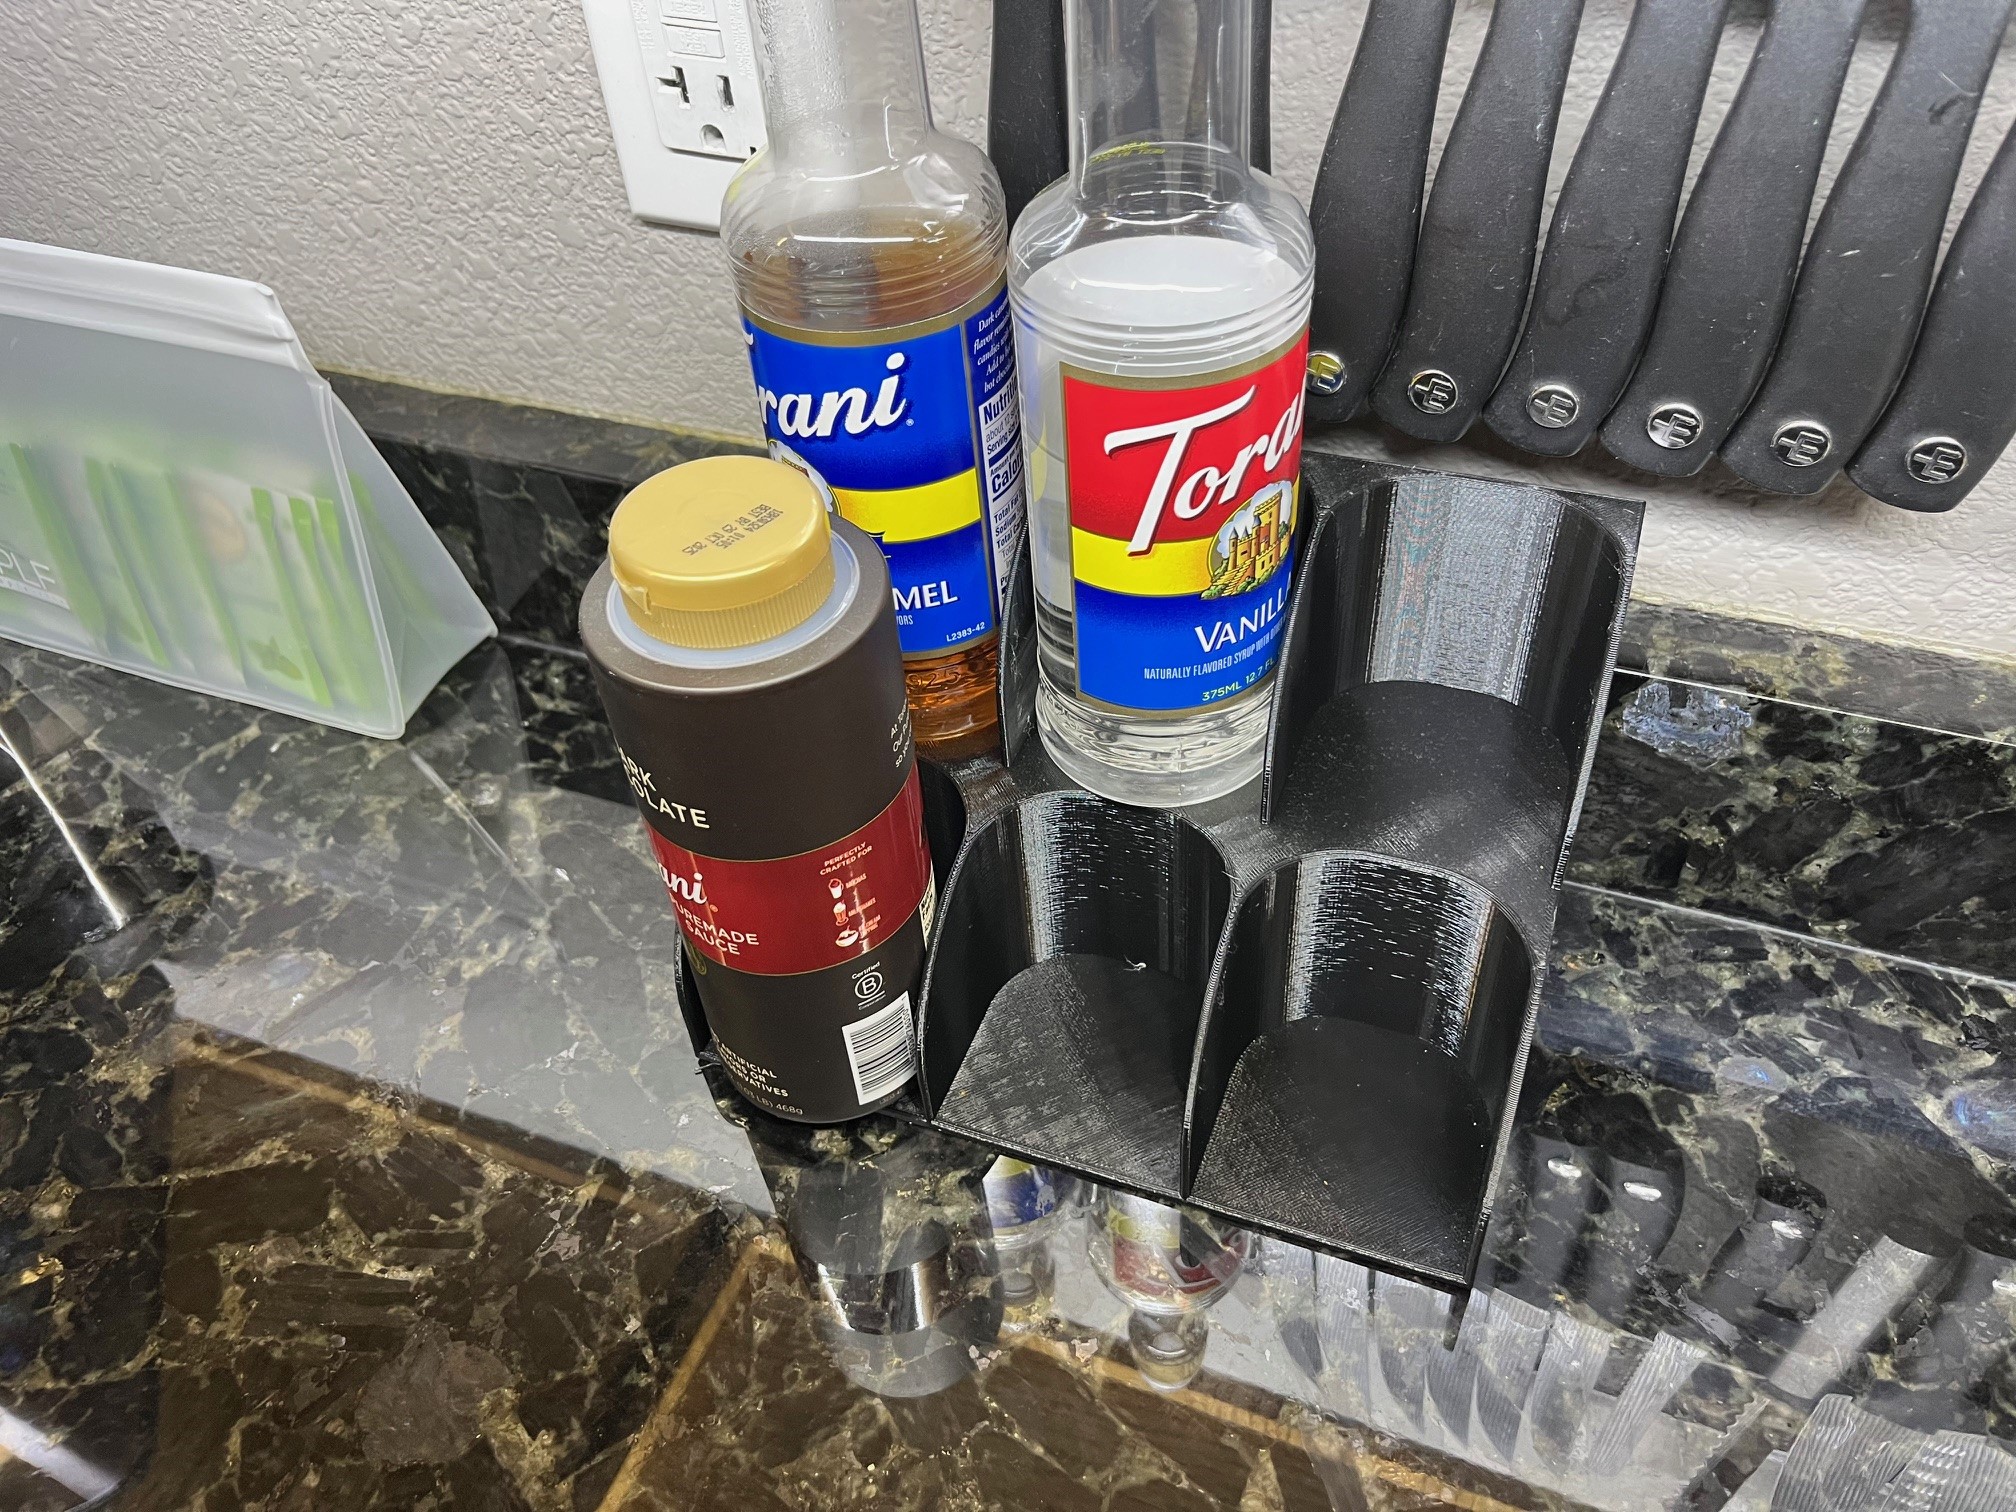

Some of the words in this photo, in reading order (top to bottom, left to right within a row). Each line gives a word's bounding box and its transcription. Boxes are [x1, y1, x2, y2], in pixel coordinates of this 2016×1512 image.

[977, 311, 994, 333] Dark
[973, 331, 993, 355] flavor
[985, 419, 1004, 444] about
[987, 428, 1008, 456] Serving
[991, 448, 1023, 494] Calori
[1104, 369, 1307, 553] Tora
[747, 503, 772, 519] BEST
[994, 504, 1010, 525] Total
[1011, 495, 1019, 513] Fat
[995, 515, 1017, 538] Sodium
[996, 529, 1012, 550] Total
[946, 621, 985, 642] L2383-42
[1144, 666, 1191, 680] NATURALLY
[1193, 655, 1232, 676] FLAVORED
[1233, 643, 1256, 665] SYRUP
[1202, 681, 1242, 701] 375ML
[1245, 667, 1263, 685] 12.7
[893, 732, 903, 752] Our
[895, 754, 903, 768] so
[819, 855, 857, 876] CRAFTED
[857, 845, 873, 859] FOR
[824, 841, 867, 867] PERFECTLY
[685, 919, 741, 955] SAUCE
[851, 961, 880, 980] Certified
[721, 1043, 777, 1079] ARTIFICIAL
[750, 1071, 766, 1083] OR
[776, 1103, 804, 1116] 468g
